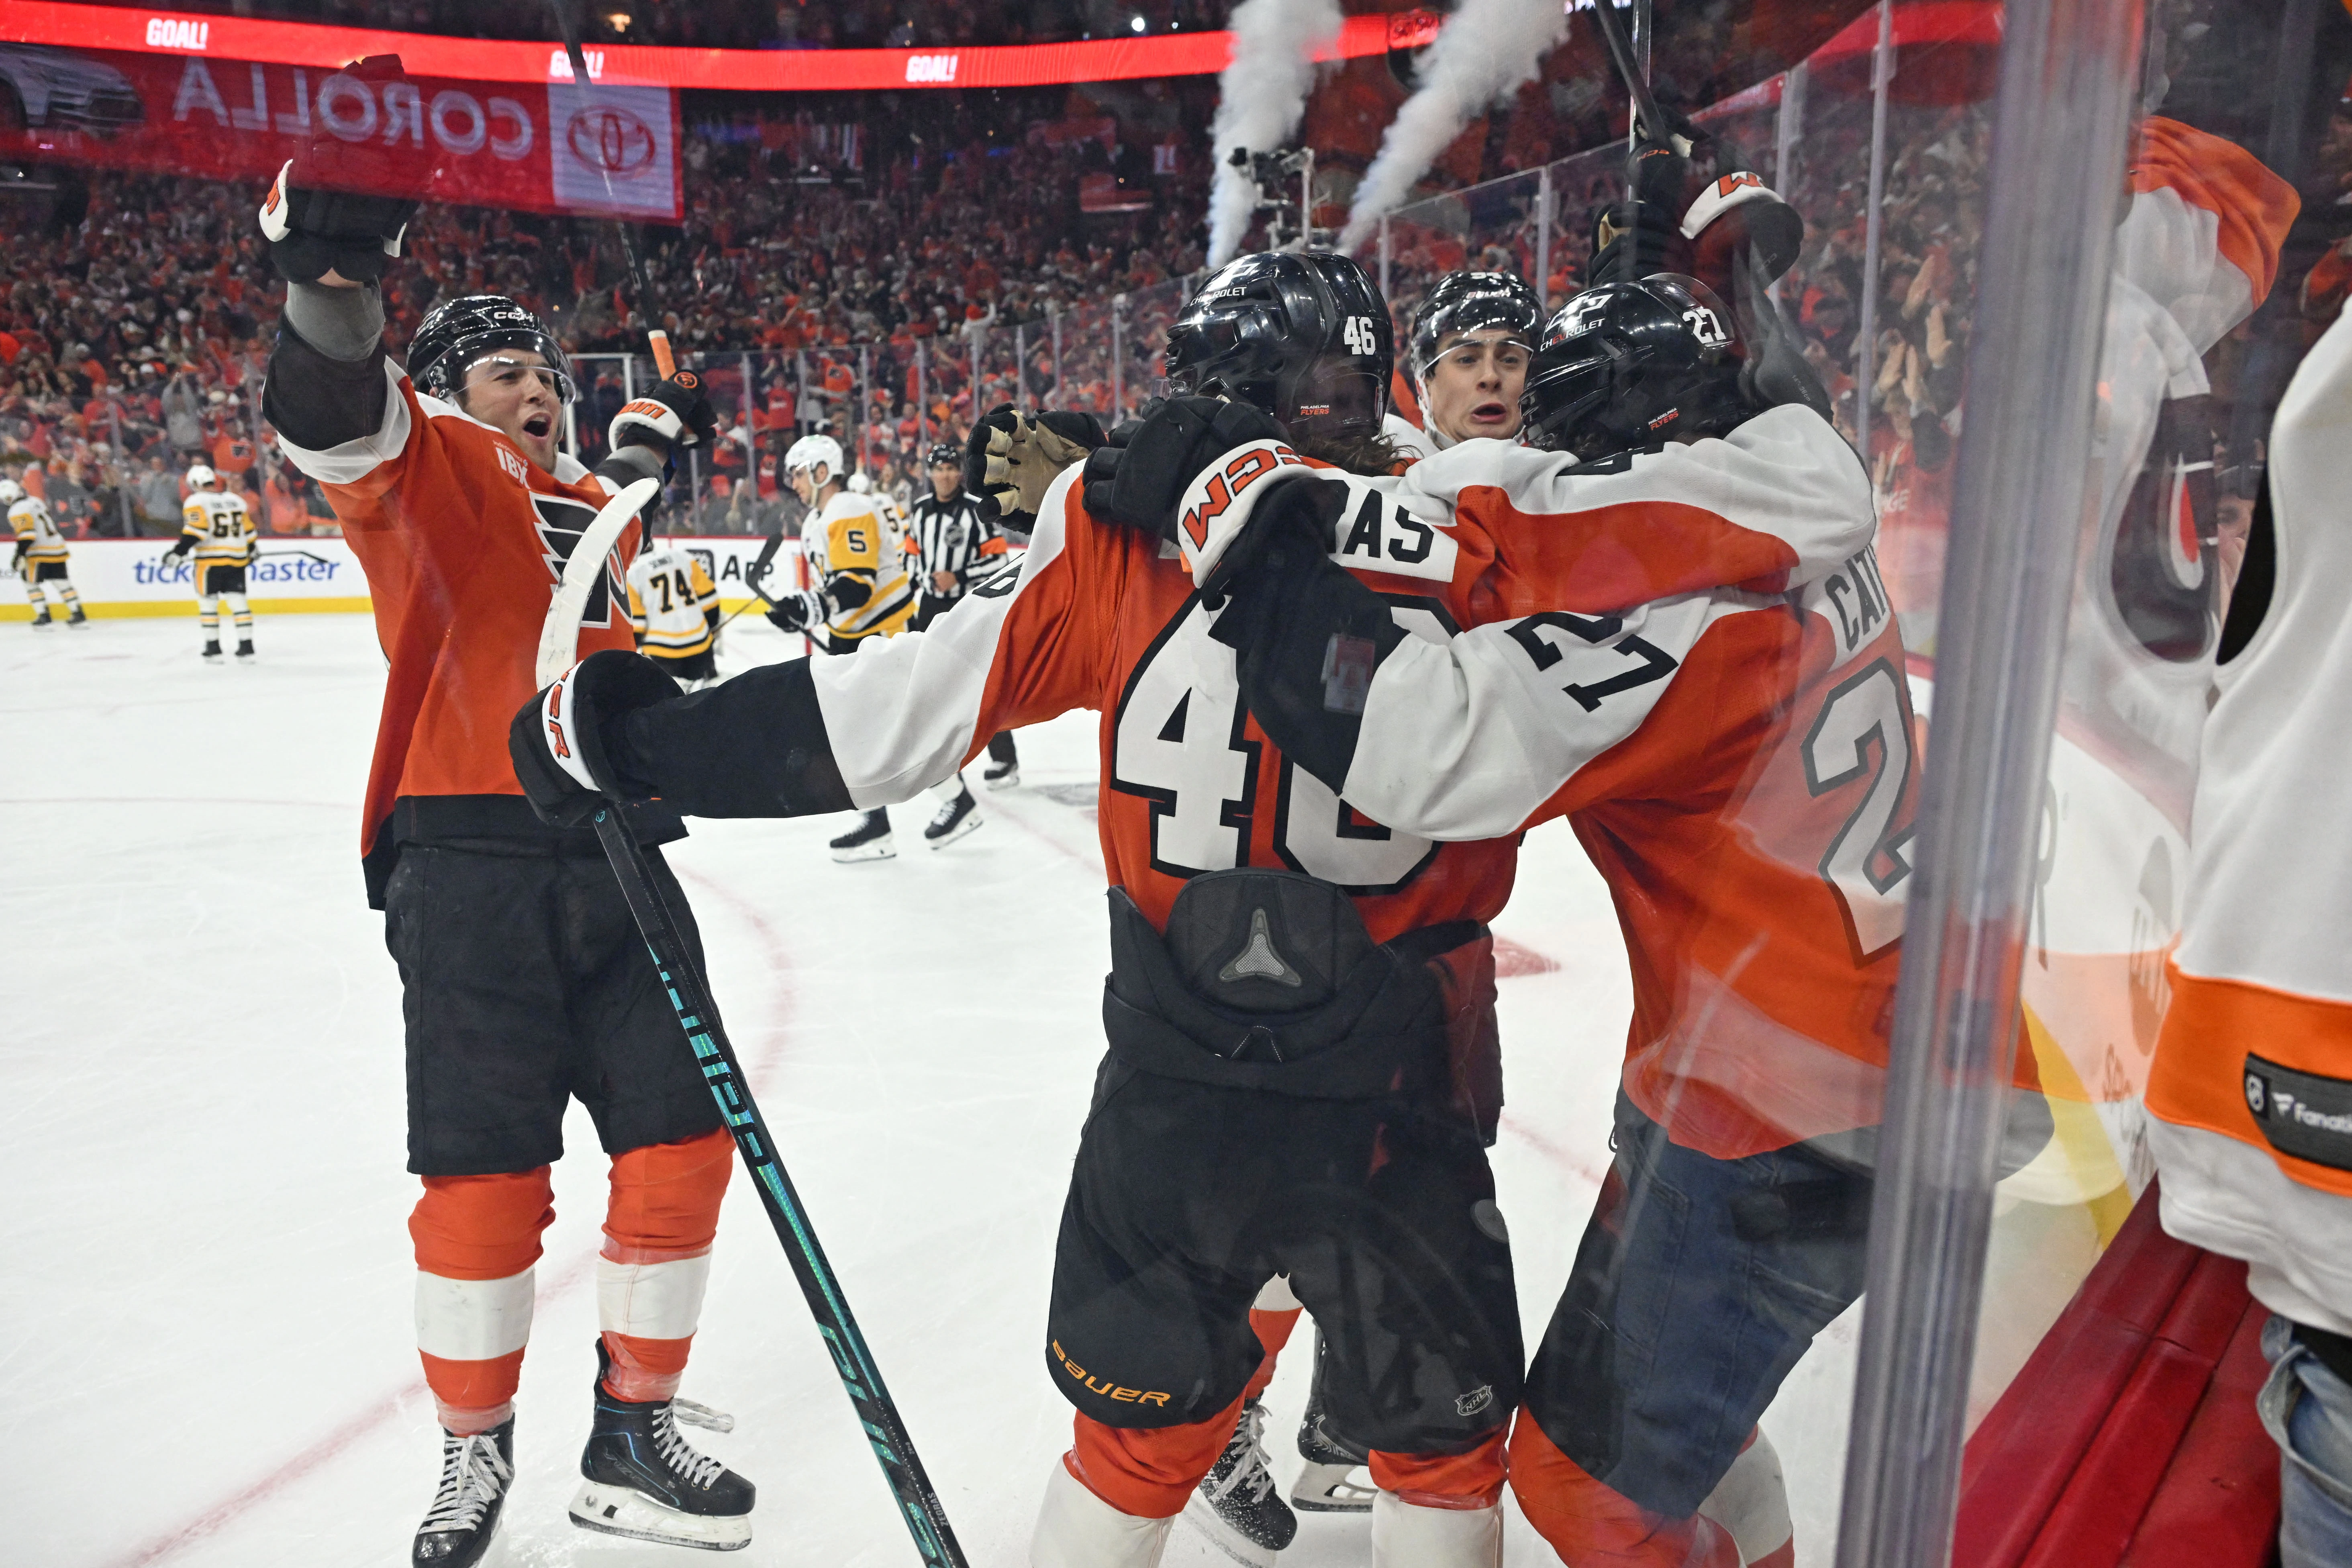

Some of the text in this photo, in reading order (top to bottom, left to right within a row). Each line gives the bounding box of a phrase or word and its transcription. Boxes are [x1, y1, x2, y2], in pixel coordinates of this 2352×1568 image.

[146, 18, 208, 50] GOAL!
[550, 50, 604, 79] GOL!
[905, 55, 958, 82] GOAL!
[1190, 286, 1247, 306] CHROLET
[494, 311, 535, 323] CCM
[1682, 308, 1726, 344] 27
[1344, 316, 1376, 355] 46
[1540, 318, 1605, 352] CHEVROLET
[1648, 407, 1677, 425] PHILADELPHIA
[1650, 410, 1679, 431] FLYERS
[495, 446, 531, 490] IBX
[848, 530, 868, 553] 5
[133, 557, 341, 584] tickaster
[649, 568, 696, 614] 74
[1824, 543, 1886, 652] CAT
[1504, 611, 1679, 713] 27
[1052, 1339, 1171, 1407] BAUER
[1466, 1392, 1486, 1412] NHL
